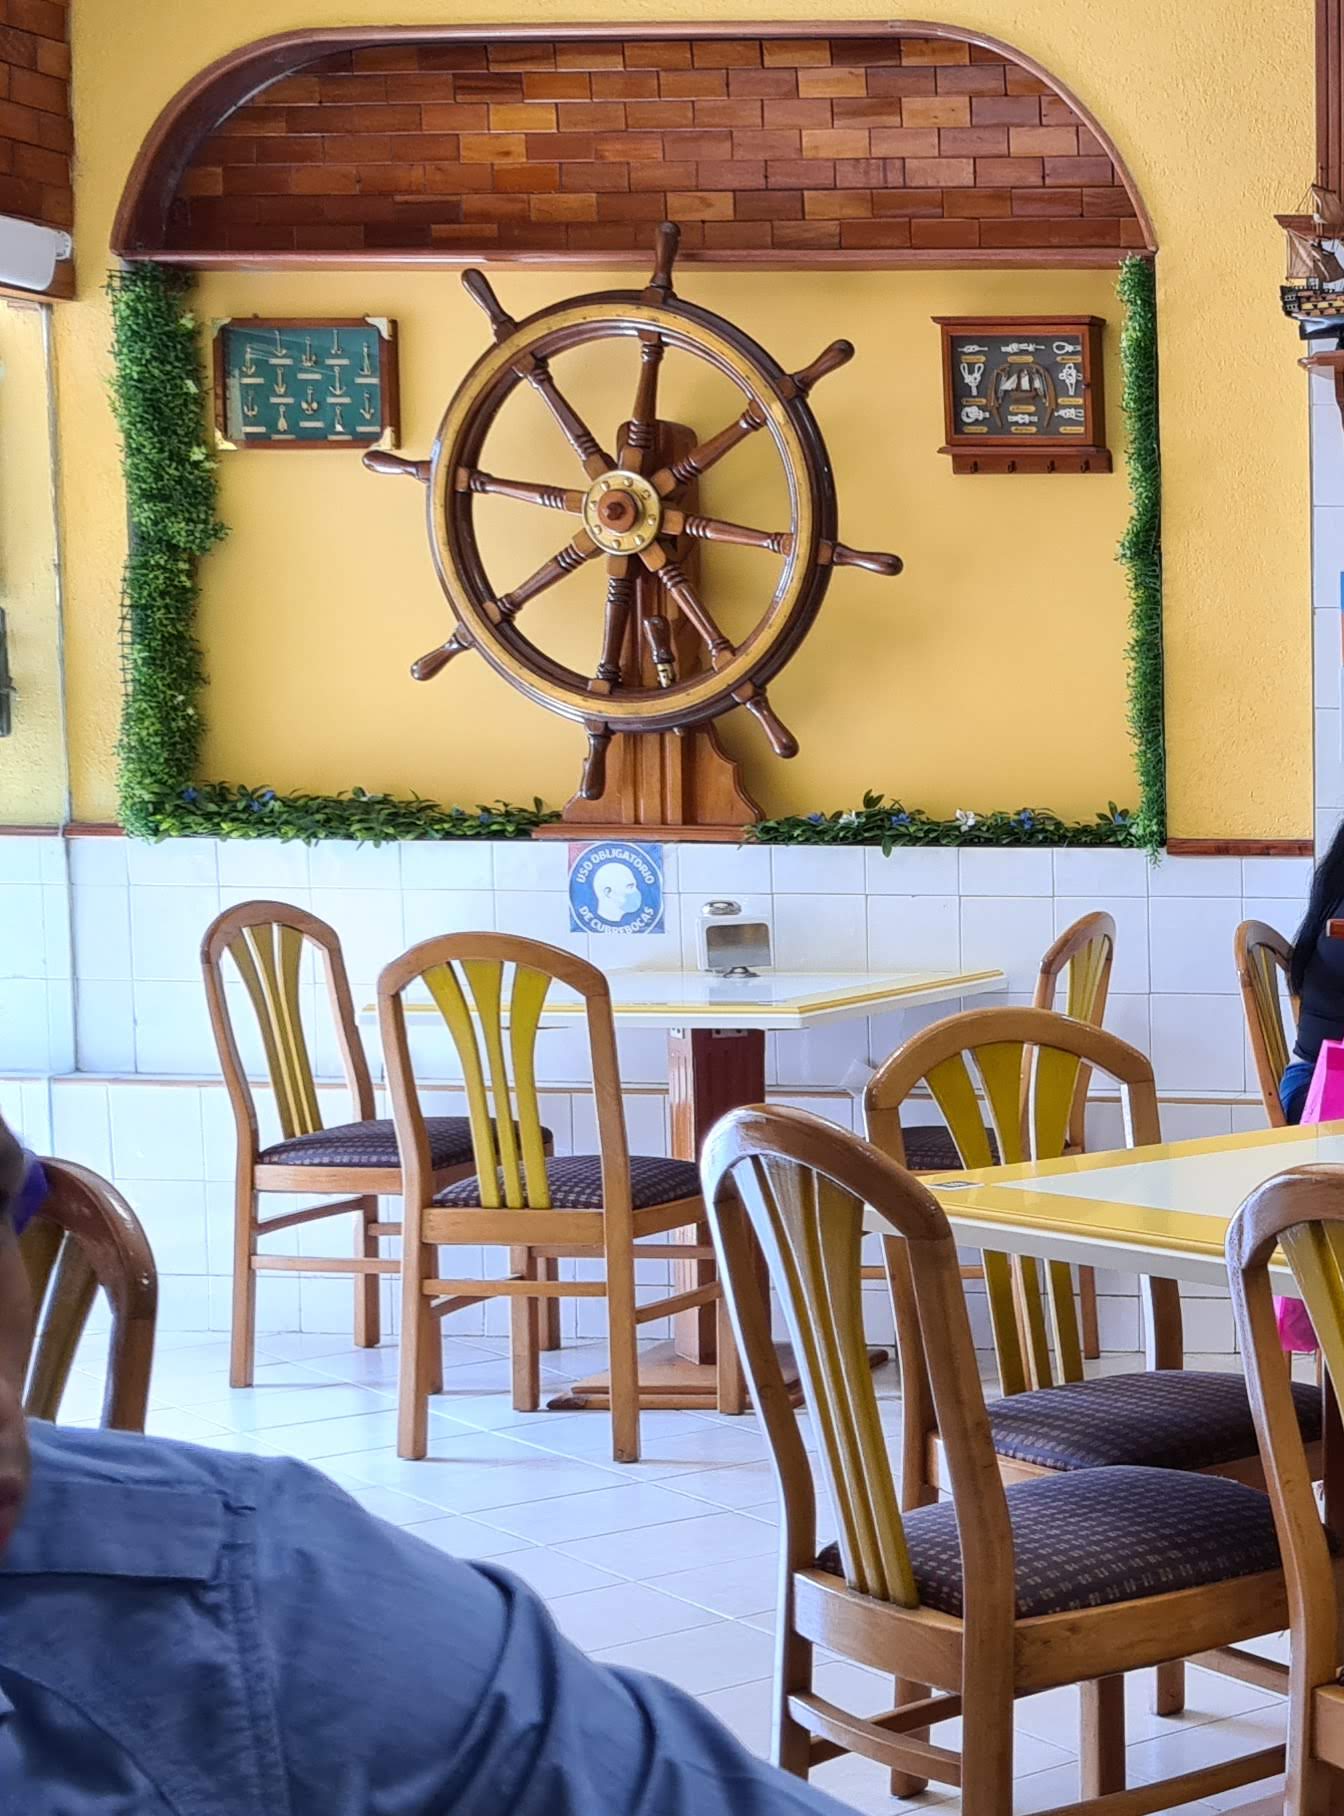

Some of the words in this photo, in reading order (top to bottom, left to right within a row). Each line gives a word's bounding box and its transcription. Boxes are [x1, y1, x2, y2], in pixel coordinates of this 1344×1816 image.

[576, 861, 593, 884] USO
[590, 847, 655, 885] OBLIGATORIO
[578, 906, 595, 922] DE
[591, 906, 654, 934] CUBREBOCAS
